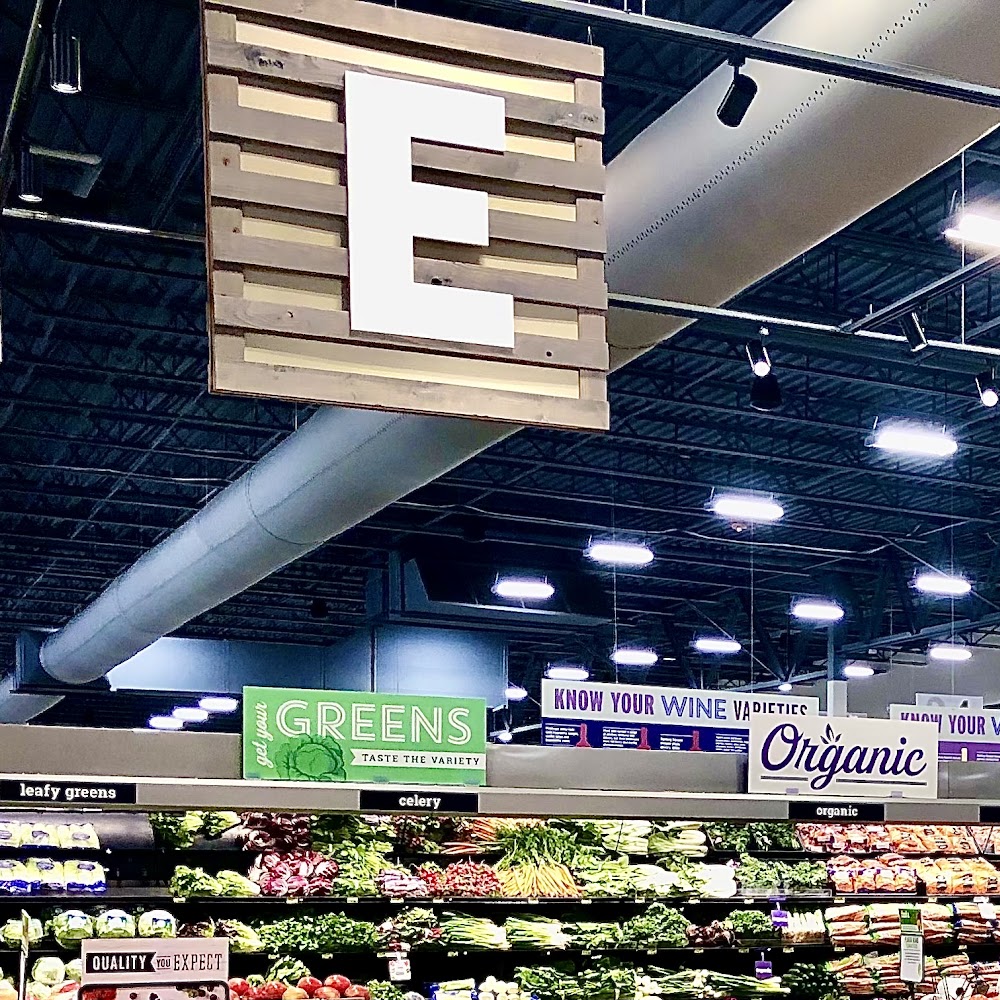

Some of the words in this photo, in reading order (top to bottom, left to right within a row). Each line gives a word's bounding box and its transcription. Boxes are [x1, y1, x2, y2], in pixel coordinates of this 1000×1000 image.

[345, 70, 516, 348] E
[554, 688, 604, 712] KNOW
[610, 692, 655, 715] YOUR
[660, 695, 727, 720] WINE
[251, 702, 275, 742] your
[275, 699, 473, 746] GREENS
[948, 714, 986, 735] YOUR
[252, 741, 275, 768] get
[362, 753, 399, 763] TASTE
[404, 755, 427, 764] THE
[432, 756, 481, 766] VARIETY
[761, 723, 928, 790] Organic
[20, 783, 60, 800] leafy
[65, 787, 117, 801] greens
[398, 794, 441, 810] celery
[816, 806, 859, 819] organic
[92, 955, 147, 971] QUALITY
[156, 958, 171, 968] YOU
[173, 953, 223, 971] EXPECT
